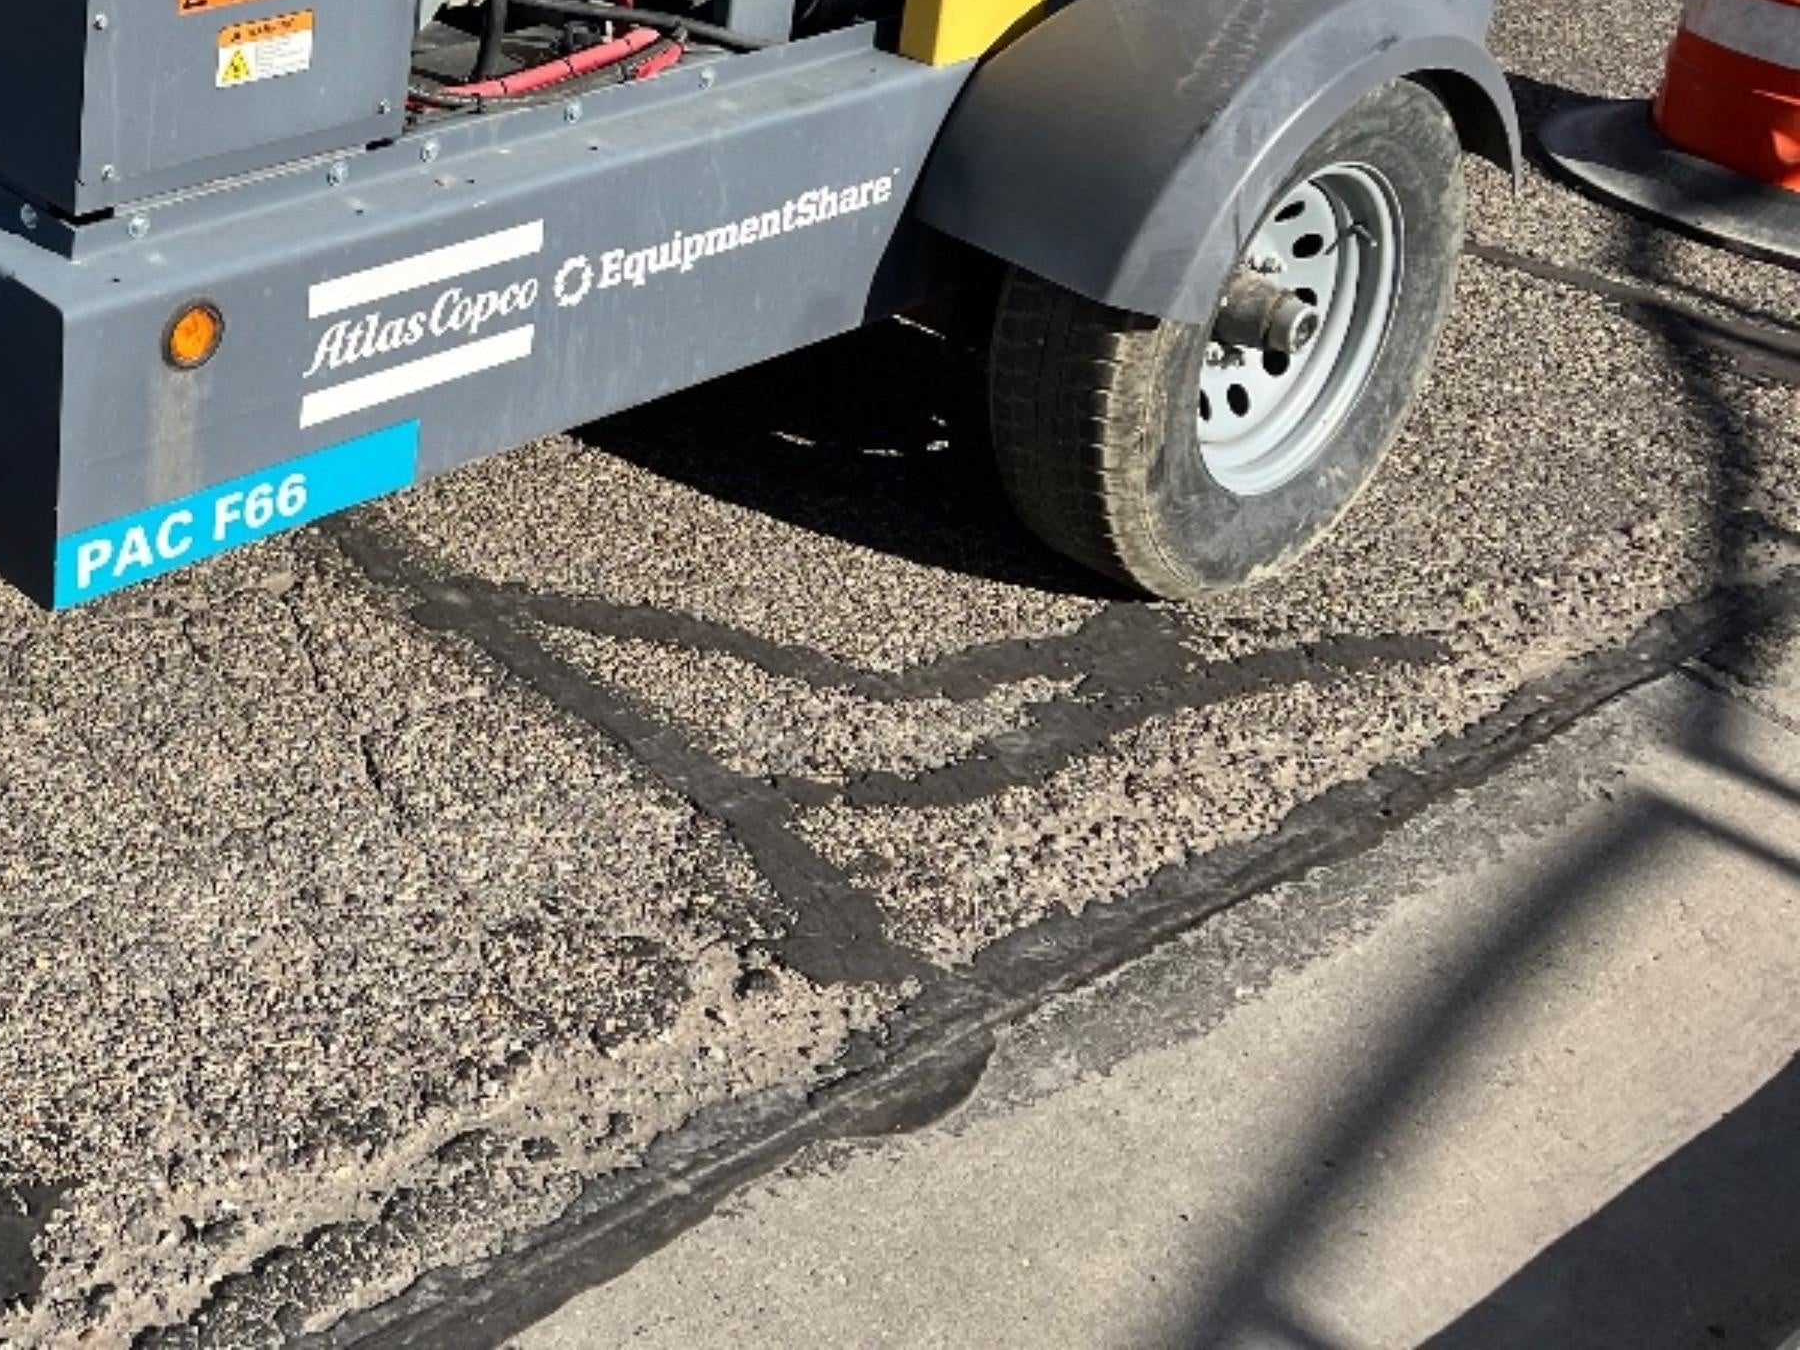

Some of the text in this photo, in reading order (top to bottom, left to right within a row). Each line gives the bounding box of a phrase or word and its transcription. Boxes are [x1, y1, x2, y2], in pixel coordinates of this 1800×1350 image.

[302, 277, 539, 379] Atlas Copco
[77, 473, 307, 589] PAC F66
